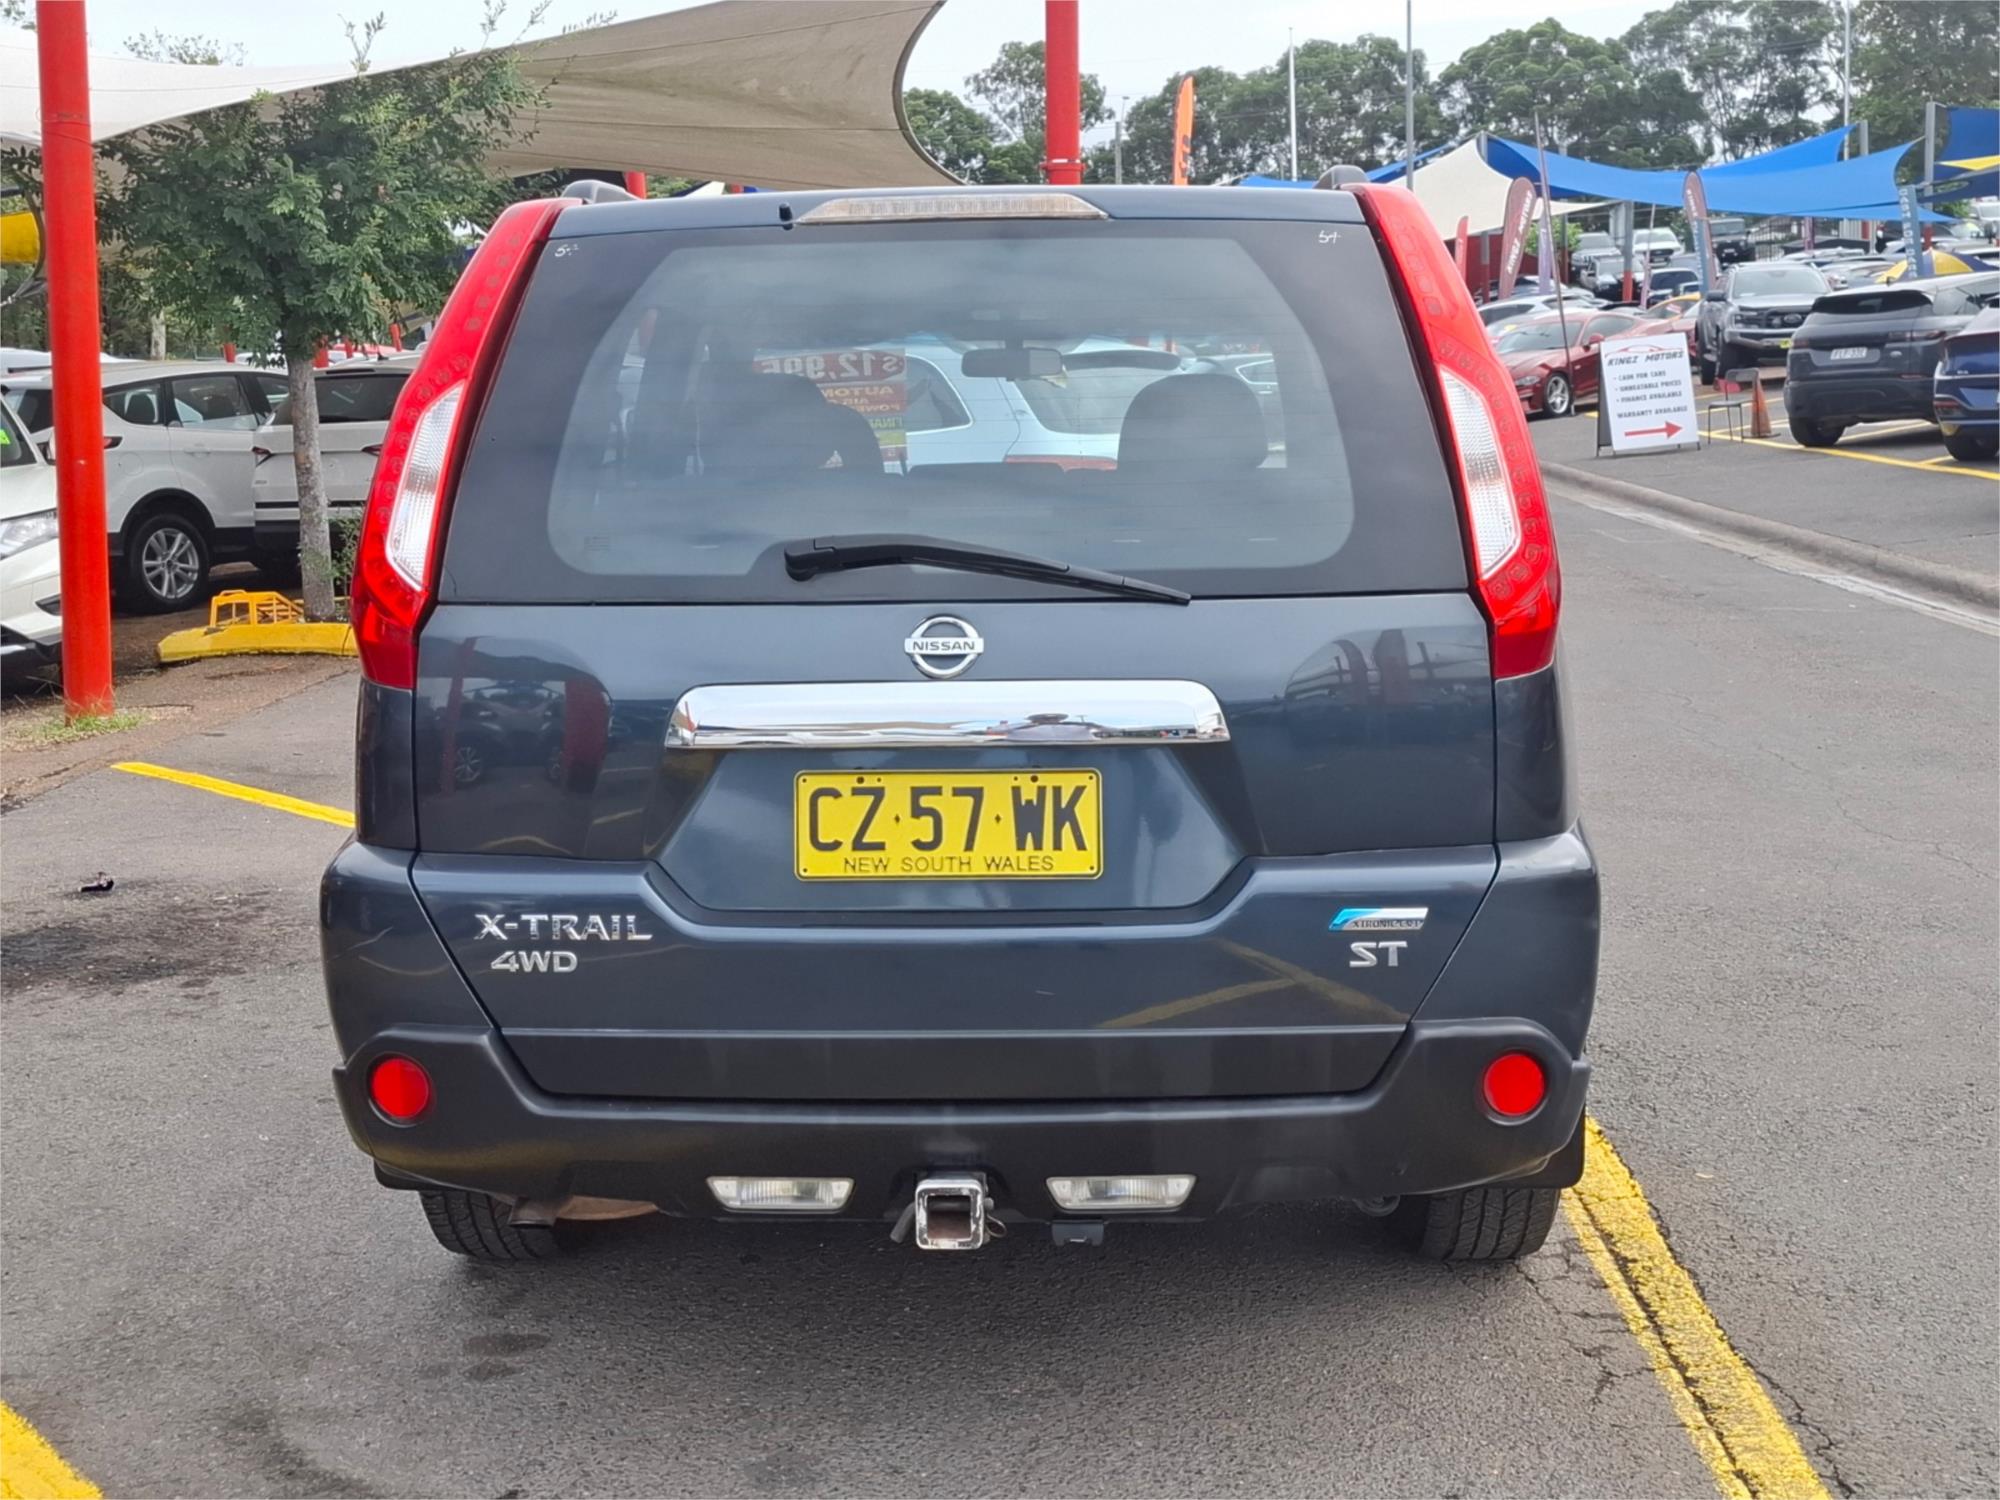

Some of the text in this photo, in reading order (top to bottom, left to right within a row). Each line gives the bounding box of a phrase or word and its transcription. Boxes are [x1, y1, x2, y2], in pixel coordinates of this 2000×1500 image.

[1607, 351, 1684, 367] KINGZ MOTORS
[912, 640, 975, 652] NISSAN
[809, 785, 1088, 851] CZ 57 WK
[844, 855, 1055, 873] NEW SOUTH WALES
[473, 913, 653, 941] X-TRAIL
[490, 951, 578, 973] 4WD
[1349, 941, 1408, 967] ST
